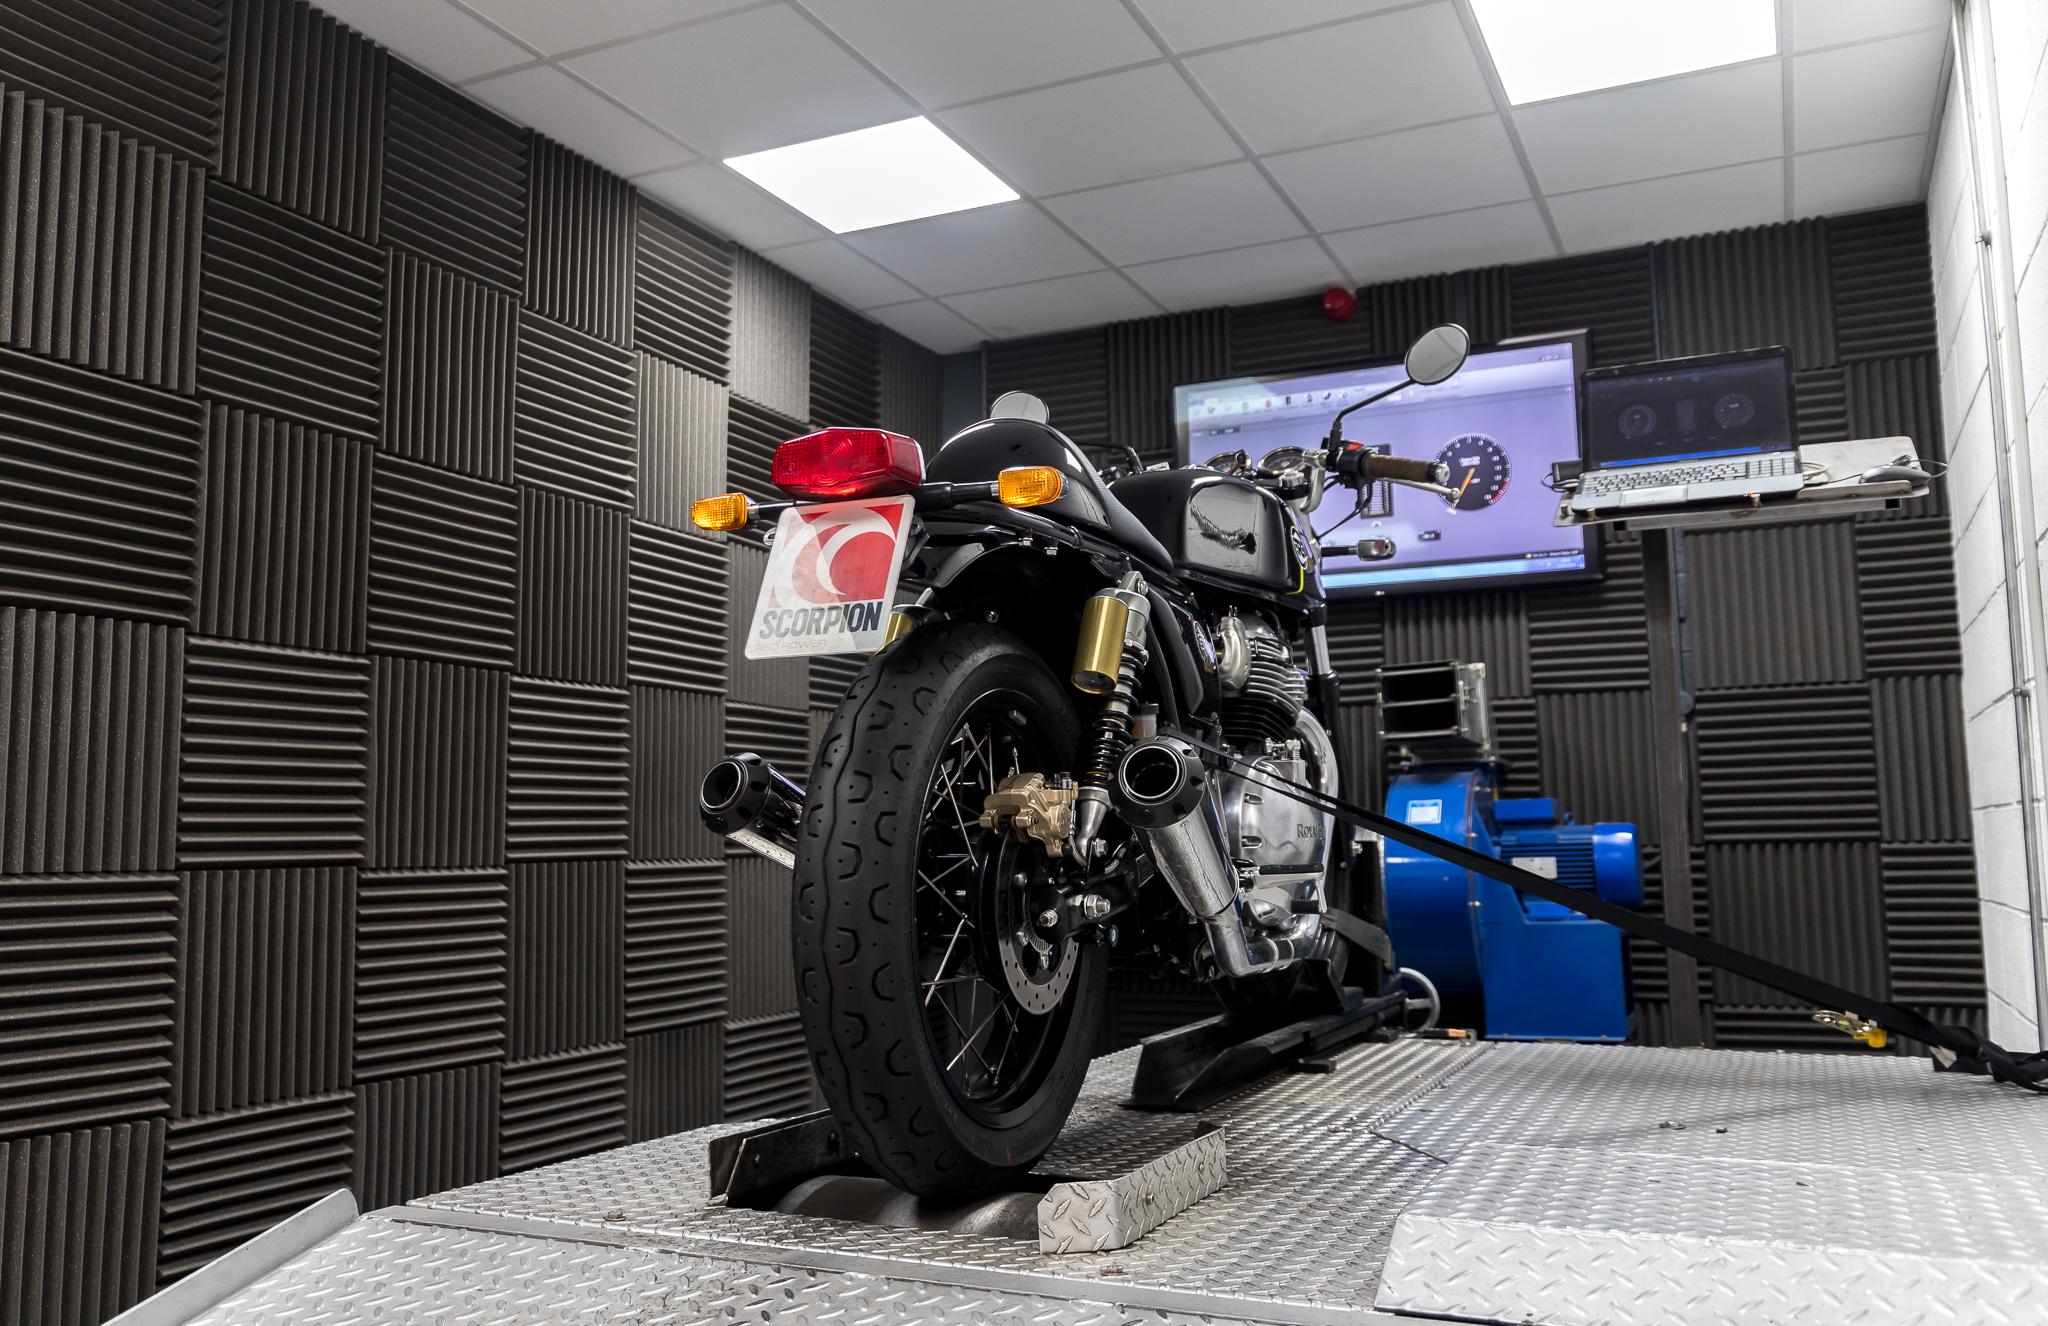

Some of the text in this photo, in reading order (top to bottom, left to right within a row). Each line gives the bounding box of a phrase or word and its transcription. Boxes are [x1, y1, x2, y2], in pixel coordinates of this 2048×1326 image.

[759, 602, 884, 640] SCORPION
[755, 639, 828, 652] RED POWER
